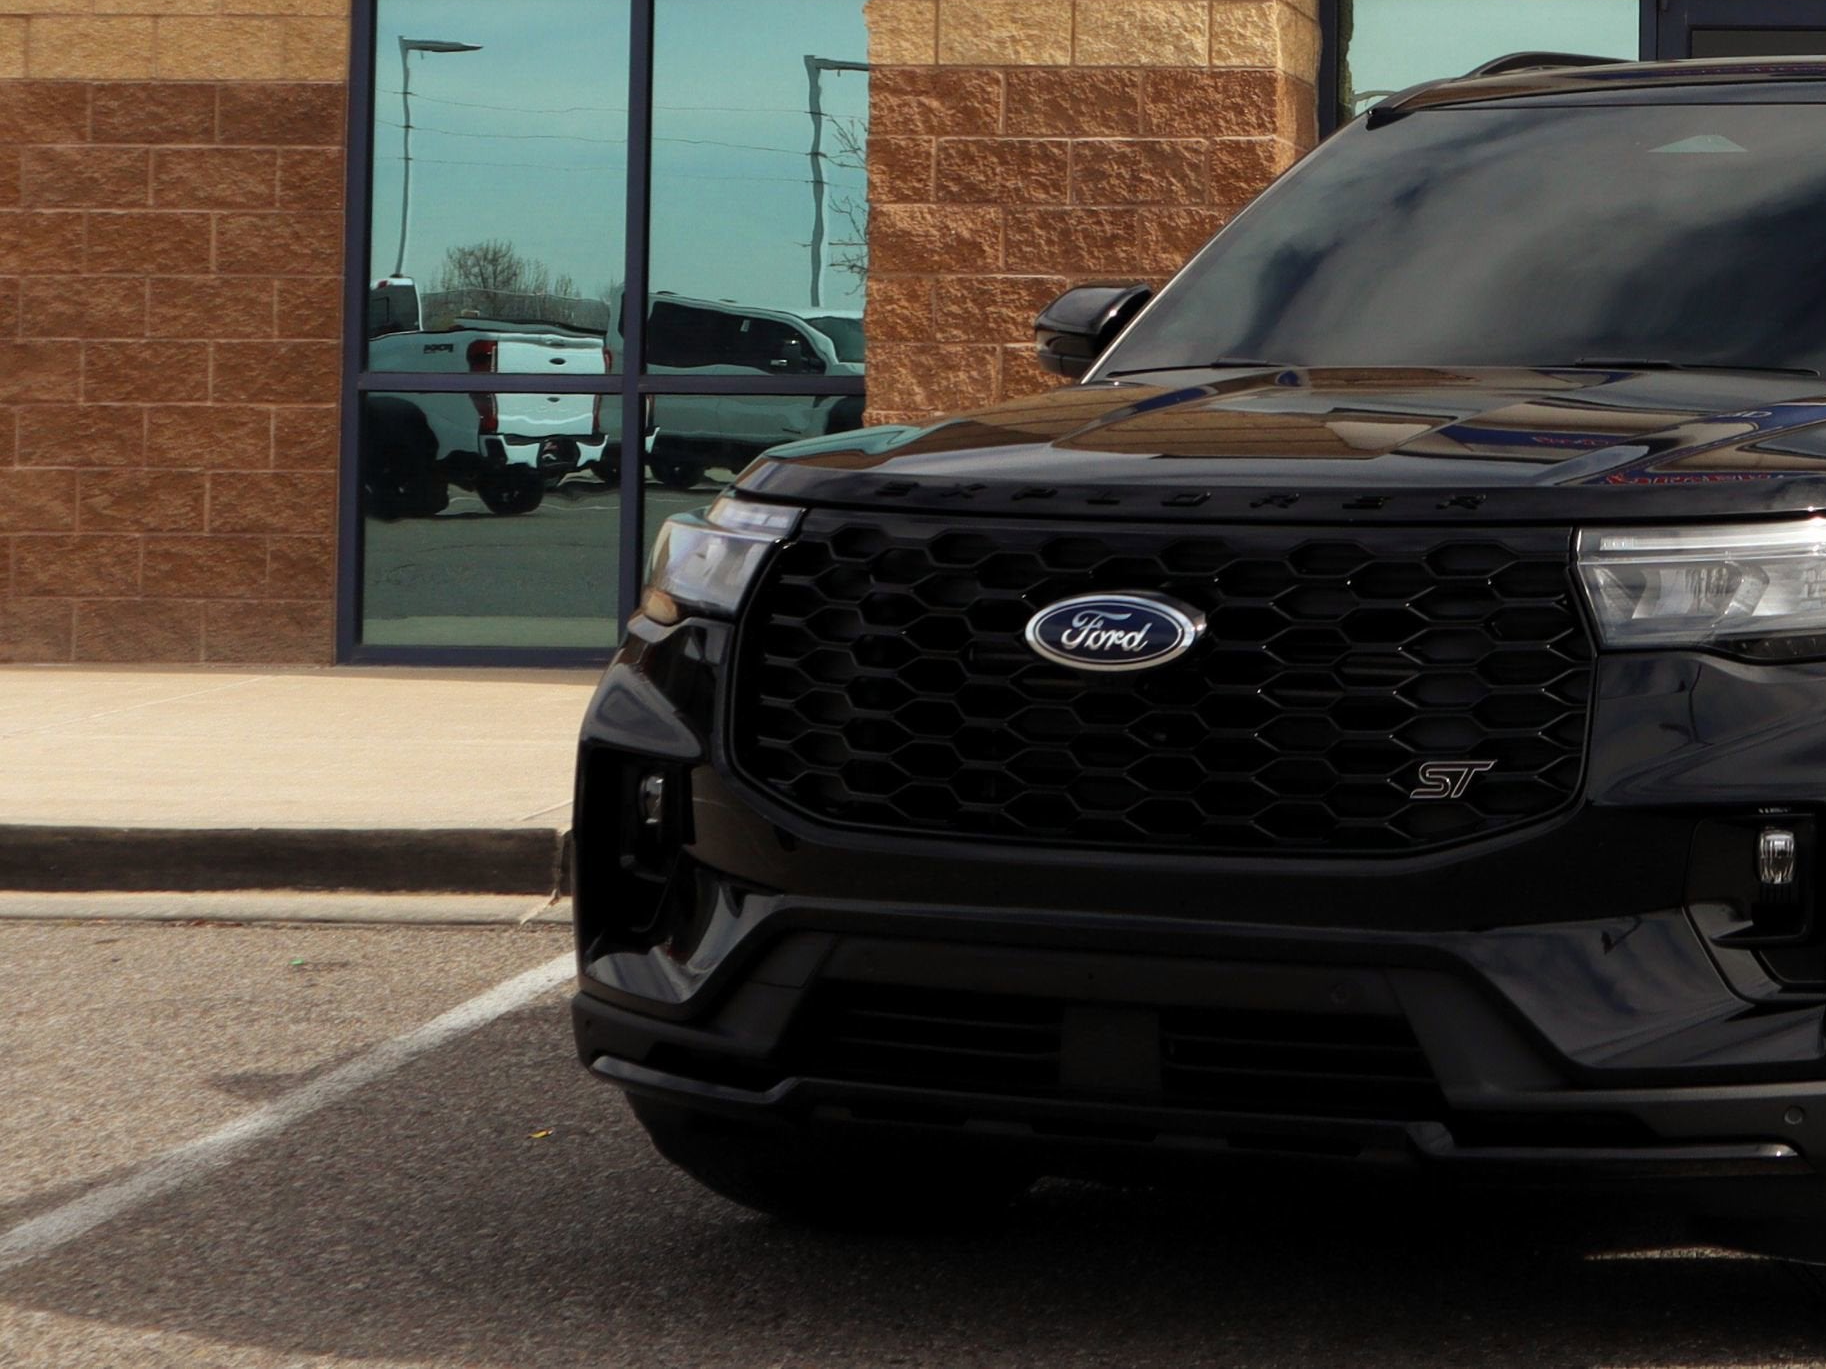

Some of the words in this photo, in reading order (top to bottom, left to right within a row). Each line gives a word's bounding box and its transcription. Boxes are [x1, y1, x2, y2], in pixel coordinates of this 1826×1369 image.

[872, 480, 1488, 511] EXPLORER
[1060, 609, 1152, 653] Ford
[1409, 758, 1498, 800] ST
